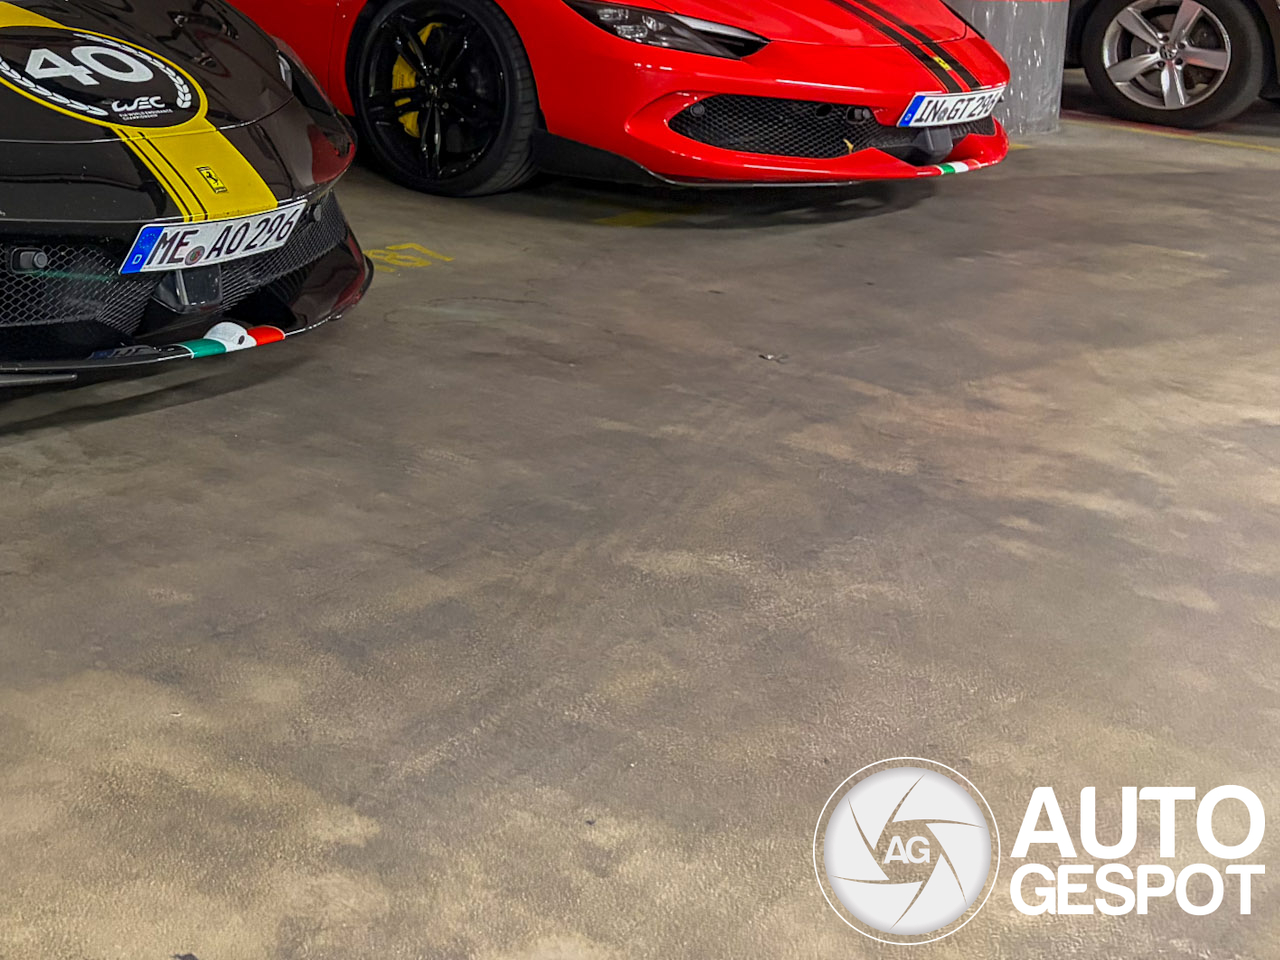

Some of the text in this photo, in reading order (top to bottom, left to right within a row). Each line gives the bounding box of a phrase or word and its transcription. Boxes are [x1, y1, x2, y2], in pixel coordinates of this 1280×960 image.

[24, 45, 154, 86] 40
[111, 96, 166, 113] WEC
[914, 100, 946, 123] IN
[946, 96, 977, 121] GT
[132, 254, 143, 265] D
[146, 229, 200, 266] ME
[244, 208, 300, 251] 296
